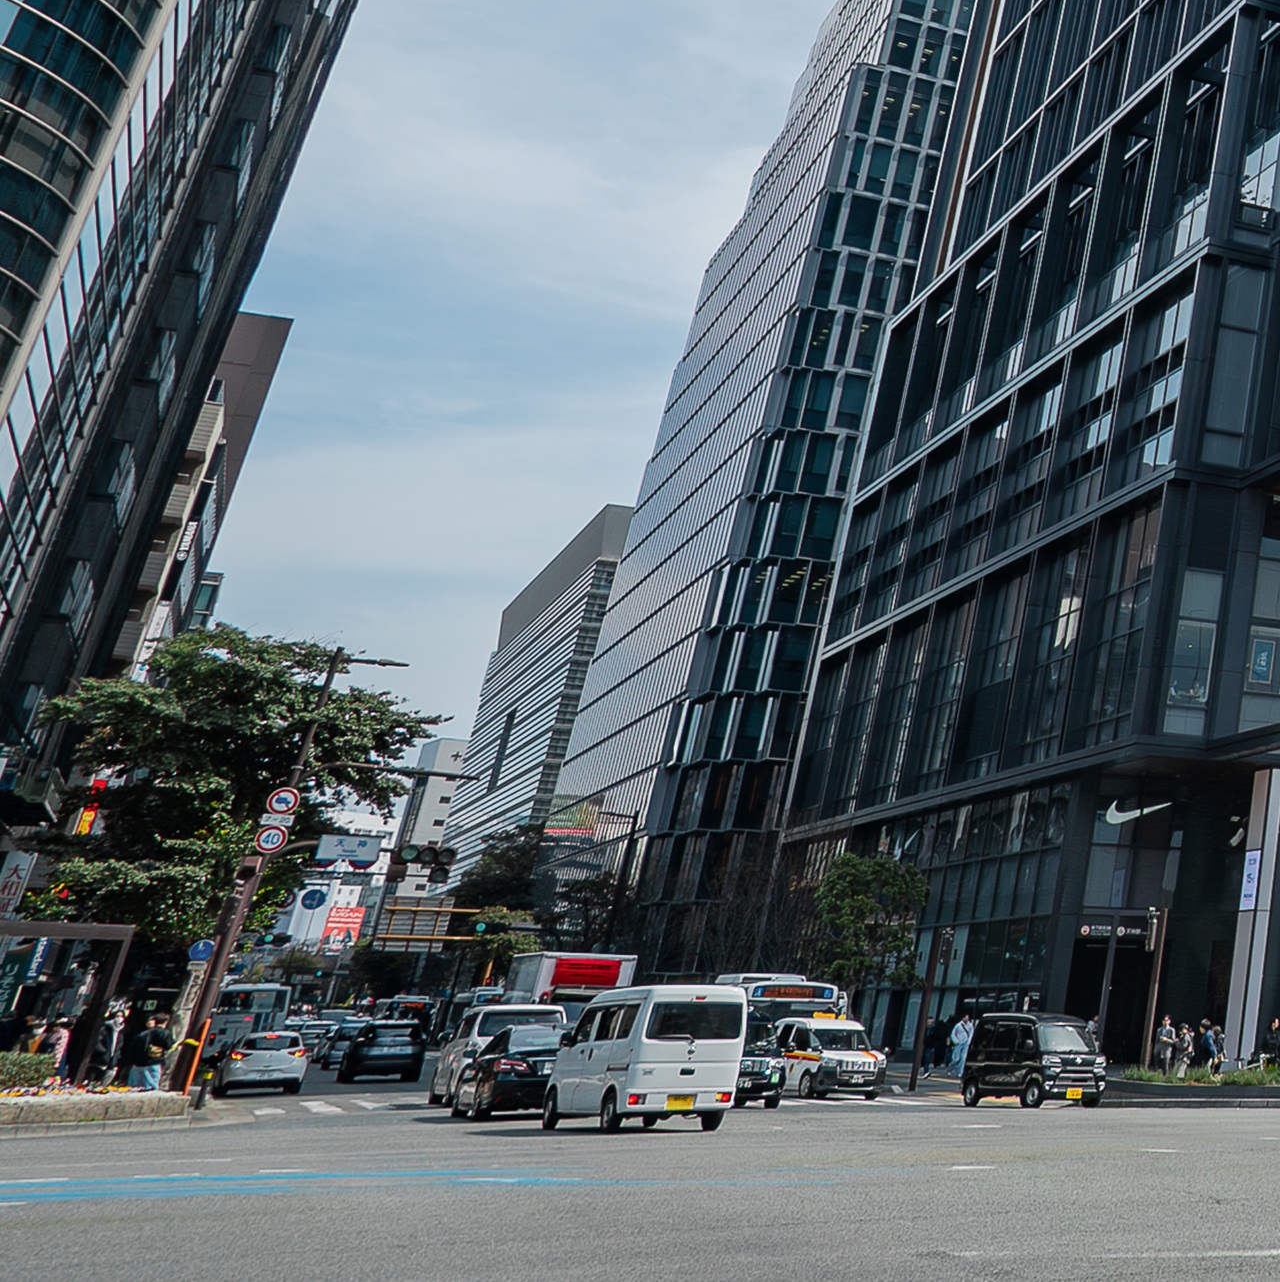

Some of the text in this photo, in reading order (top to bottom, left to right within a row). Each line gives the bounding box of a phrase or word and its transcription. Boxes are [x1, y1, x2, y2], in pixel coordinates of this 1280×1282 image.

[178, 521, 198, 551] YAMAHA
[261, 832, 282, 846] 40
[333, 838, 369, 850] 天神
